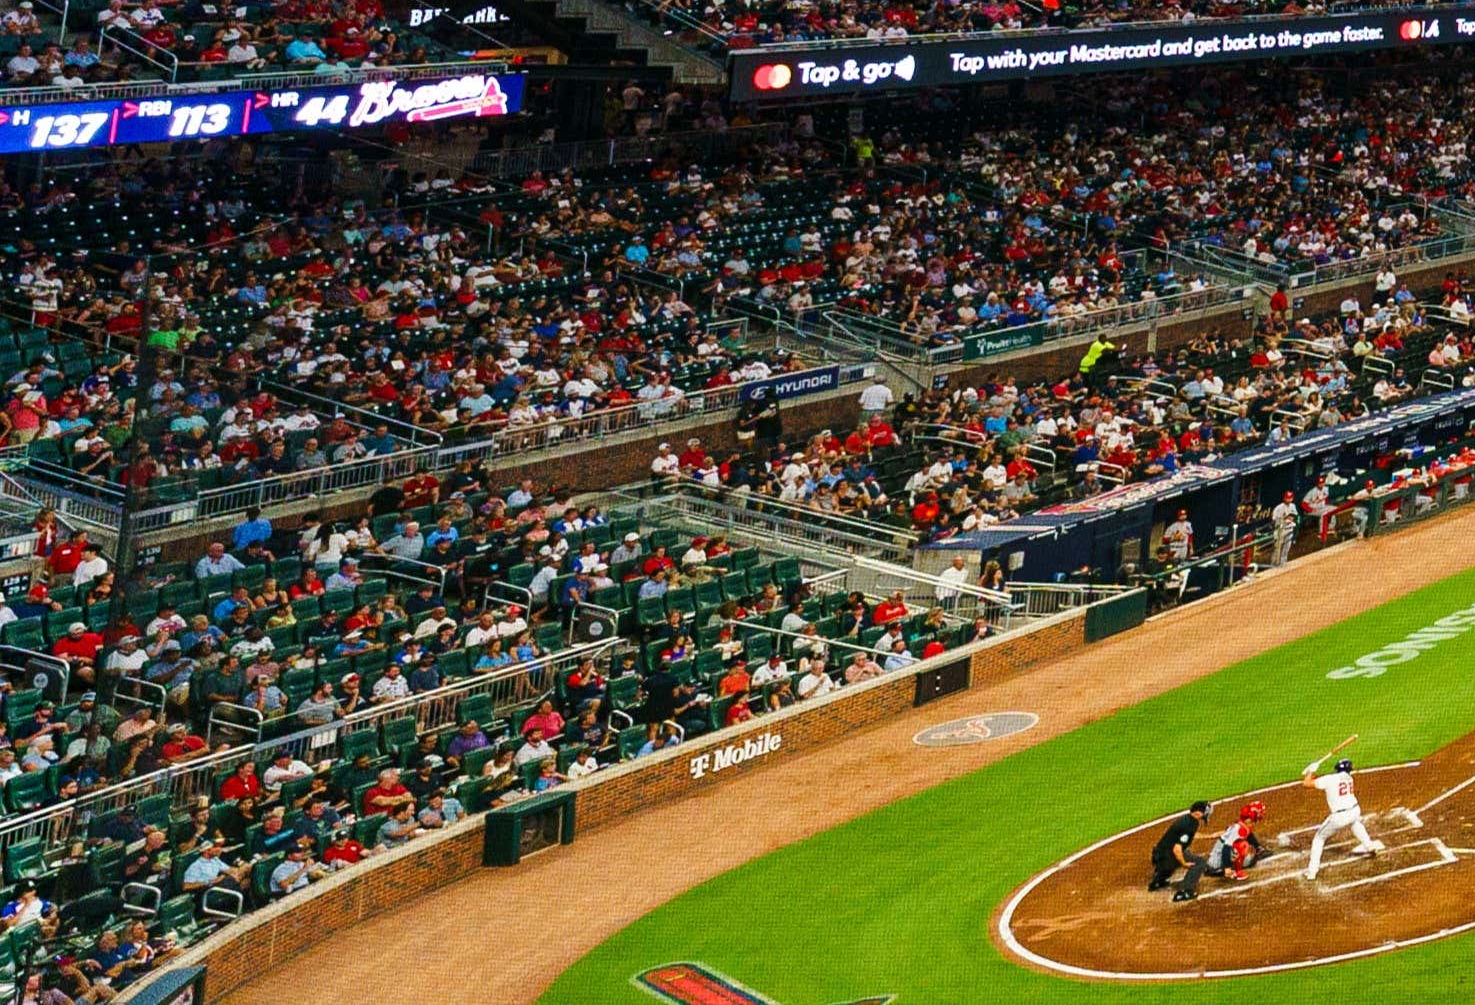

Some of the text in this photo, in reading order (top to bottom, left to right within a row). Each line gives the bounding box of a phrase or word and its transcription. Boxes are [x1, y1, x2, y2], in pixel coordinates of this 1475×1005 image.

[950, 25, 1384, 74] Tap with your Mastercard and get back to the game faster.
[798, 62, 892, 88] Tap go
[138, 101, 231, 136] RBI 113
[272, 93, 348, 124] HR 44
[30, 112, 108, 147] 137
[775, 374, 833, 395] HYUNDAI
[712, 732, 782, 772] Mobile
